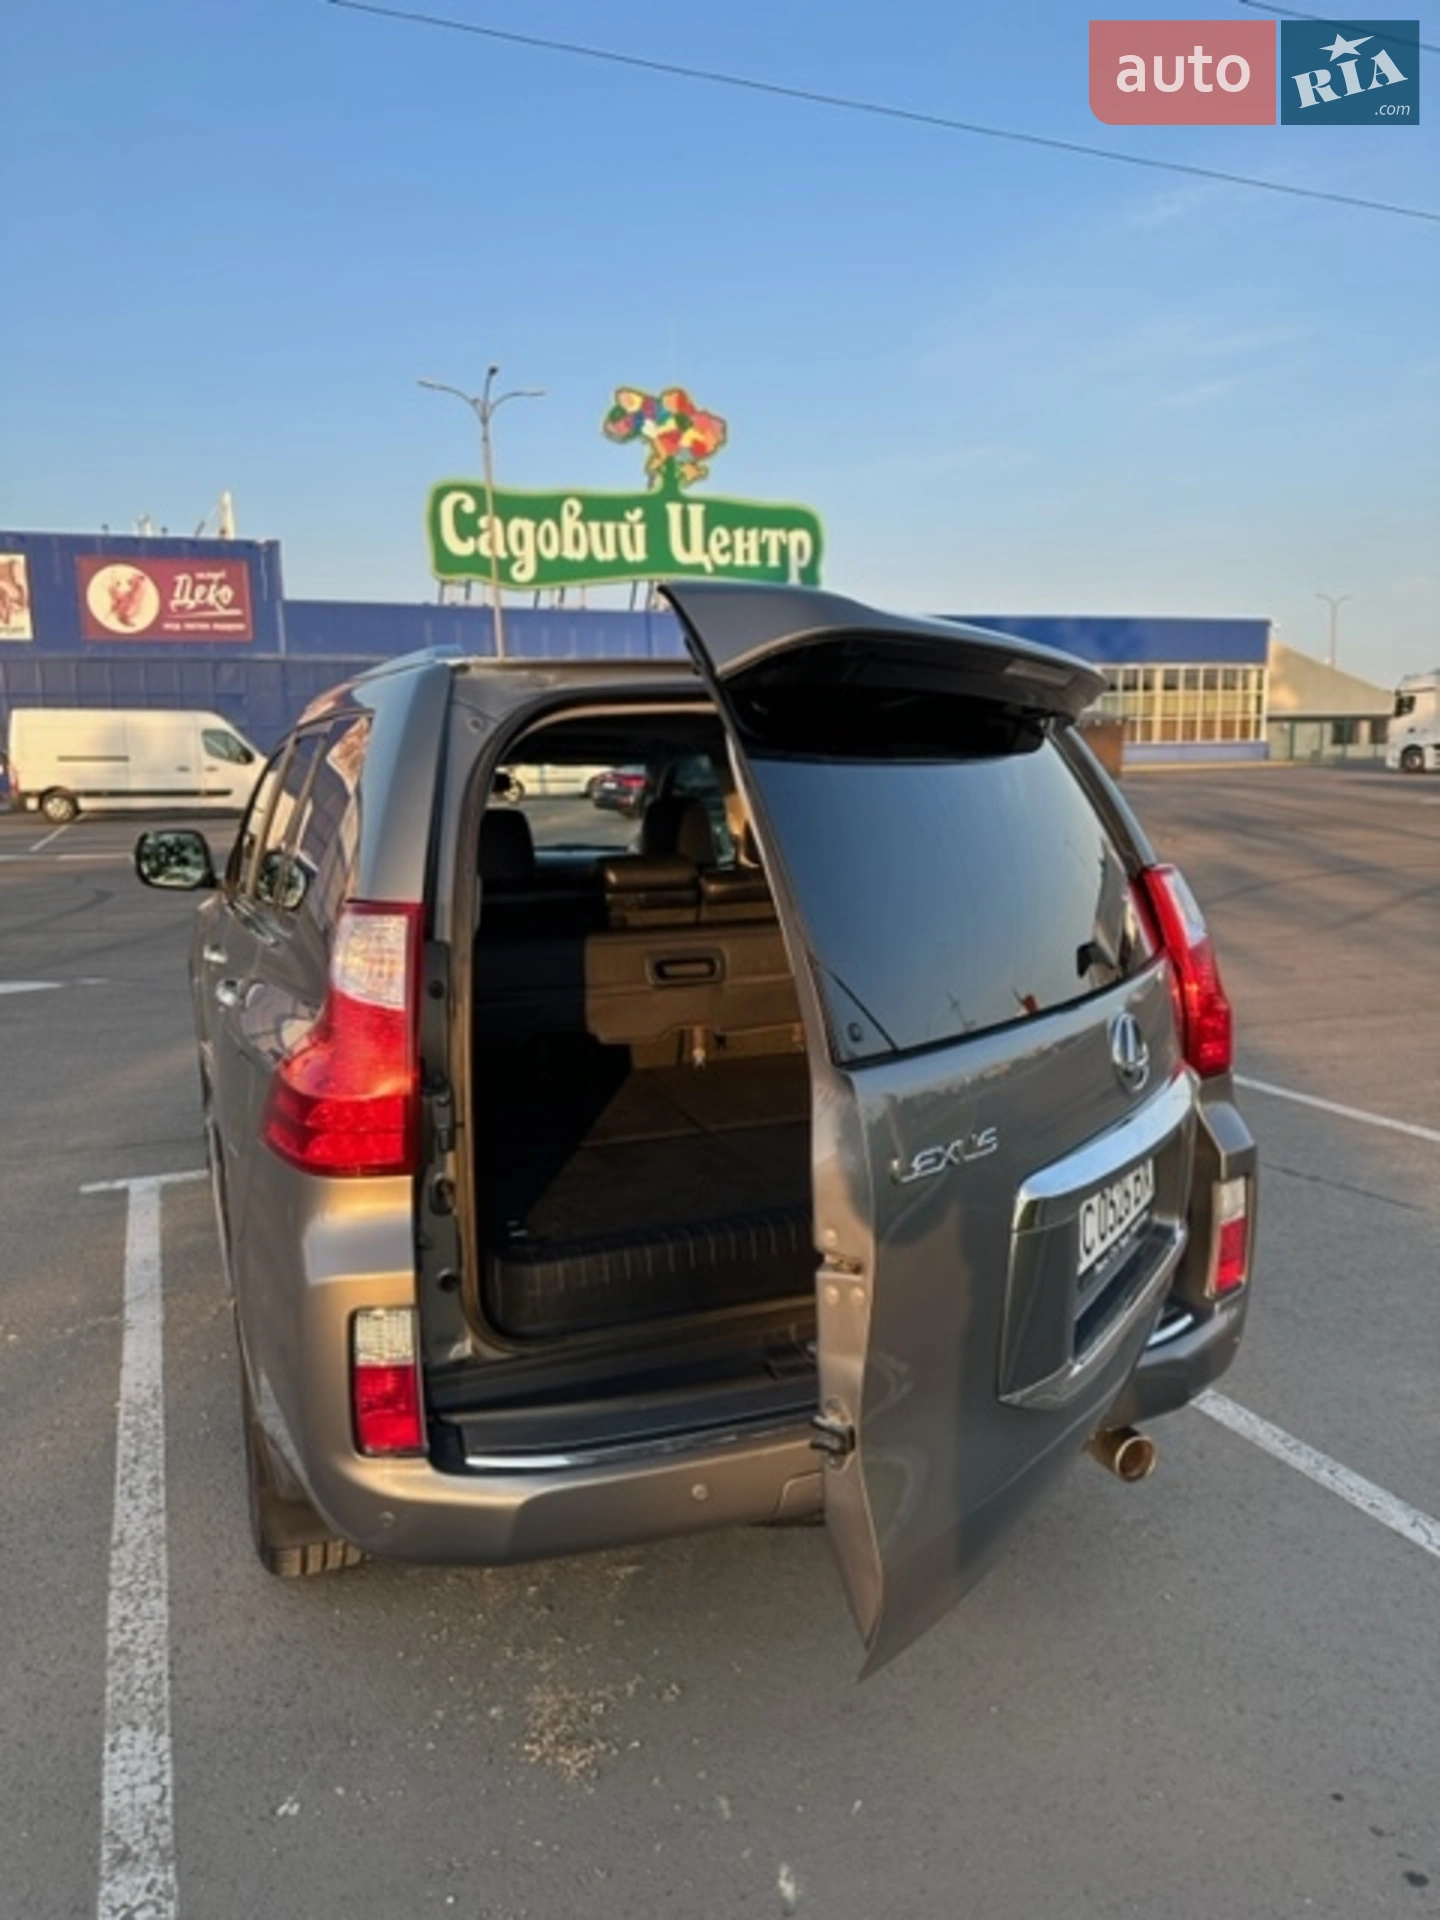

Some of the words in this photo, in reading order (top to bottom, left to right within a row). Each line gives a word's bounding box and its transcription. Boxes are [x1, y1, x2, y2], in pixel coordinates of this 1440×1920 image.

[439, 490, 648, 583] Садовий
[666, 502, 813, 585] Центр
[892, 1126, 998, 1184] LEXUS
